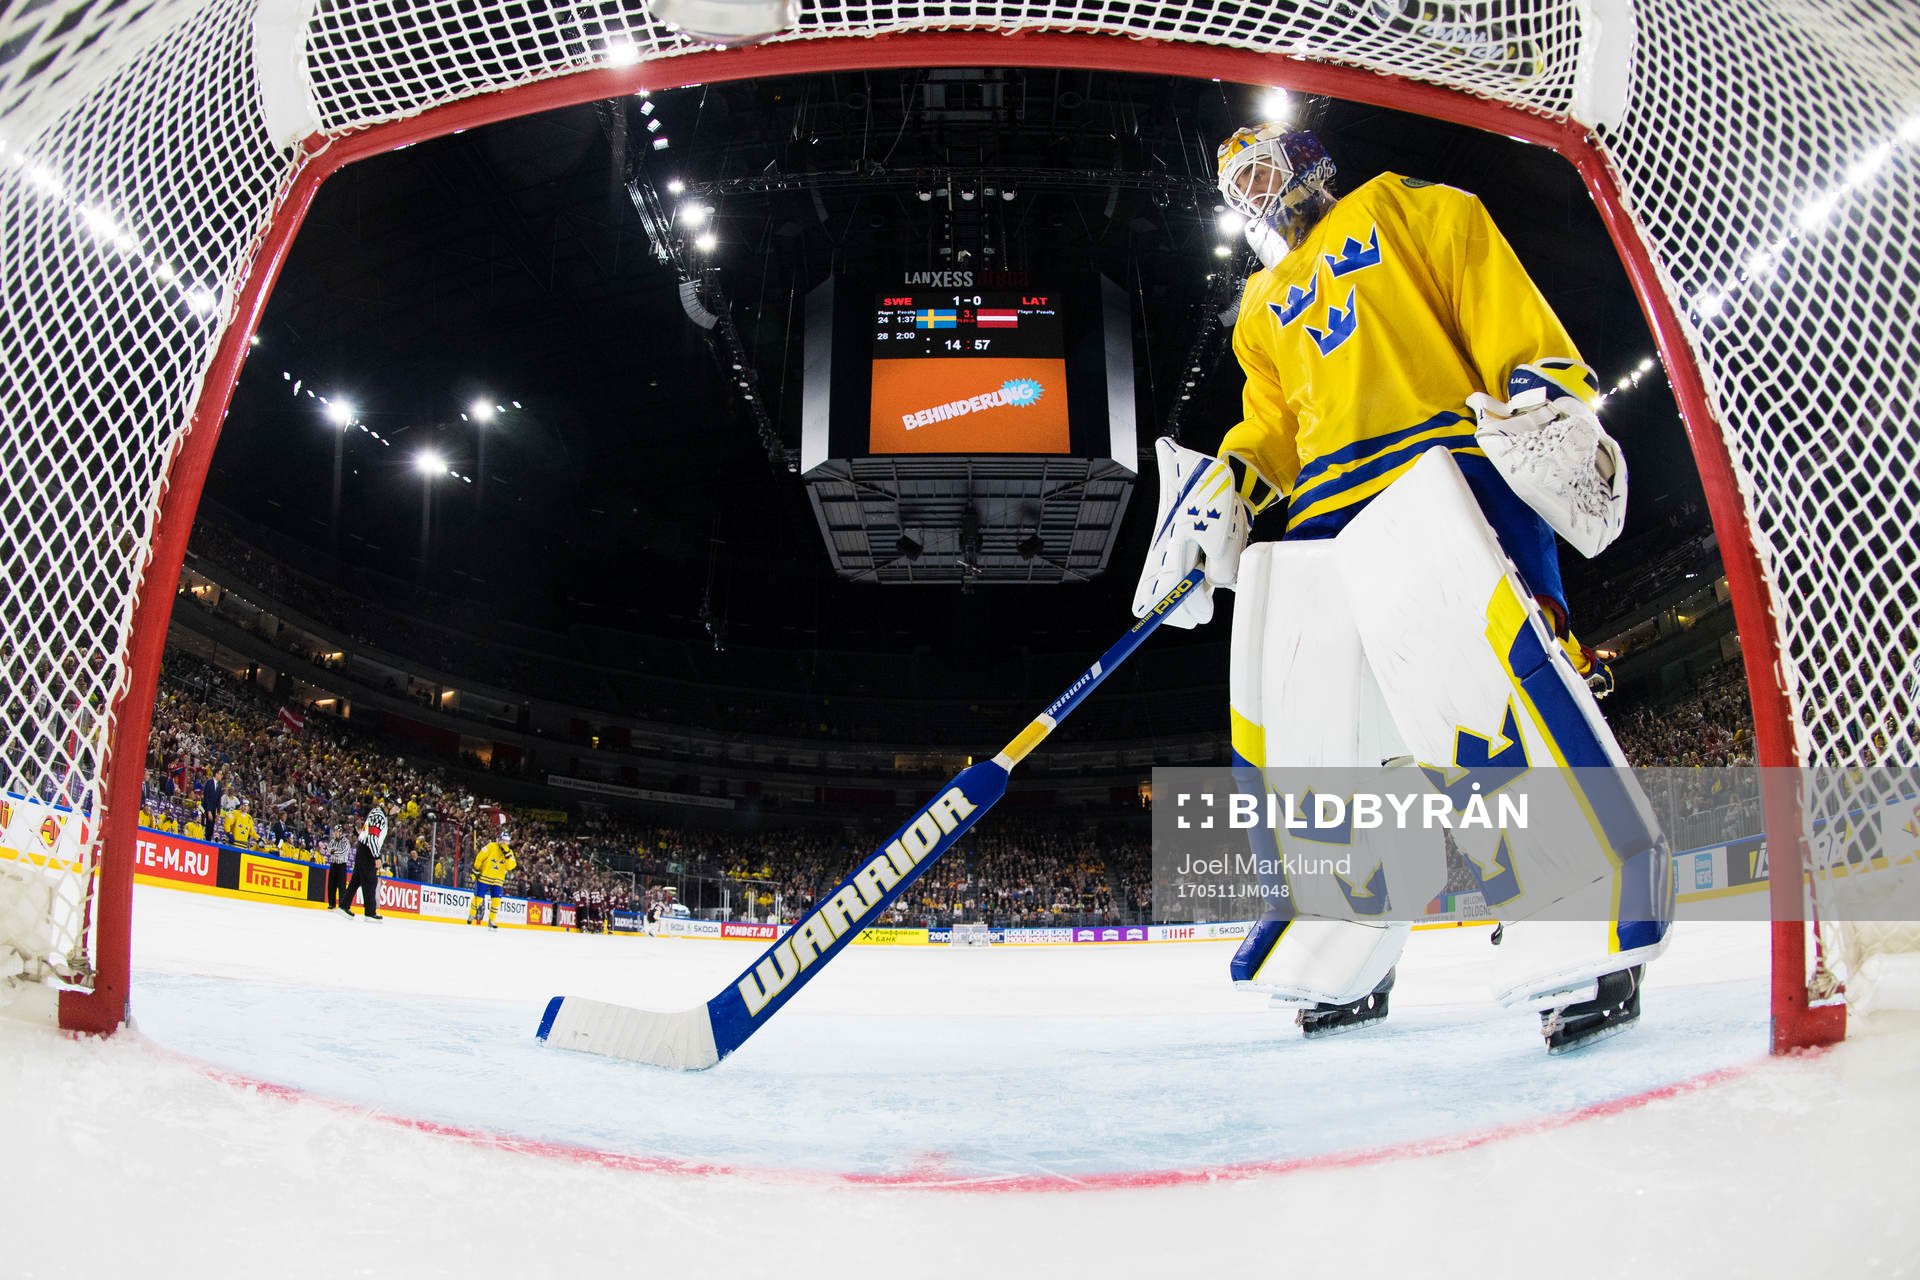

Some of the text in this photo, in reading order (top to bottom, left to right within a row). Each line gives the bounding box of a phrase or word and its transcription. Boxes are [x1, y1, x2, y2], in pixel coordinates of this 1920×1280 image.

[904, 271, 973, 287] LANXESS
[883, 298, 912, 306] SWE
[1022, 297, 1048, 306] LAT
[877, 332, 915, 340] 28 2:00
[902, 384, 1034, 430] BEHINDERUNG
[1153, 579, 1193, 615] PRO
[1044, 673, 1091, 716] ARRIOR
[246, 862, 302, 892] PIRELLI
[379, 879, 419, 910] ŠOVICE
[437, 892, 471, 908] TISSOT
[737, 786, 978, 1018] WARRIOR
[724, 925, 774, 938] FONBET.RU
[1169, 928, 1195, 939] IIHF
